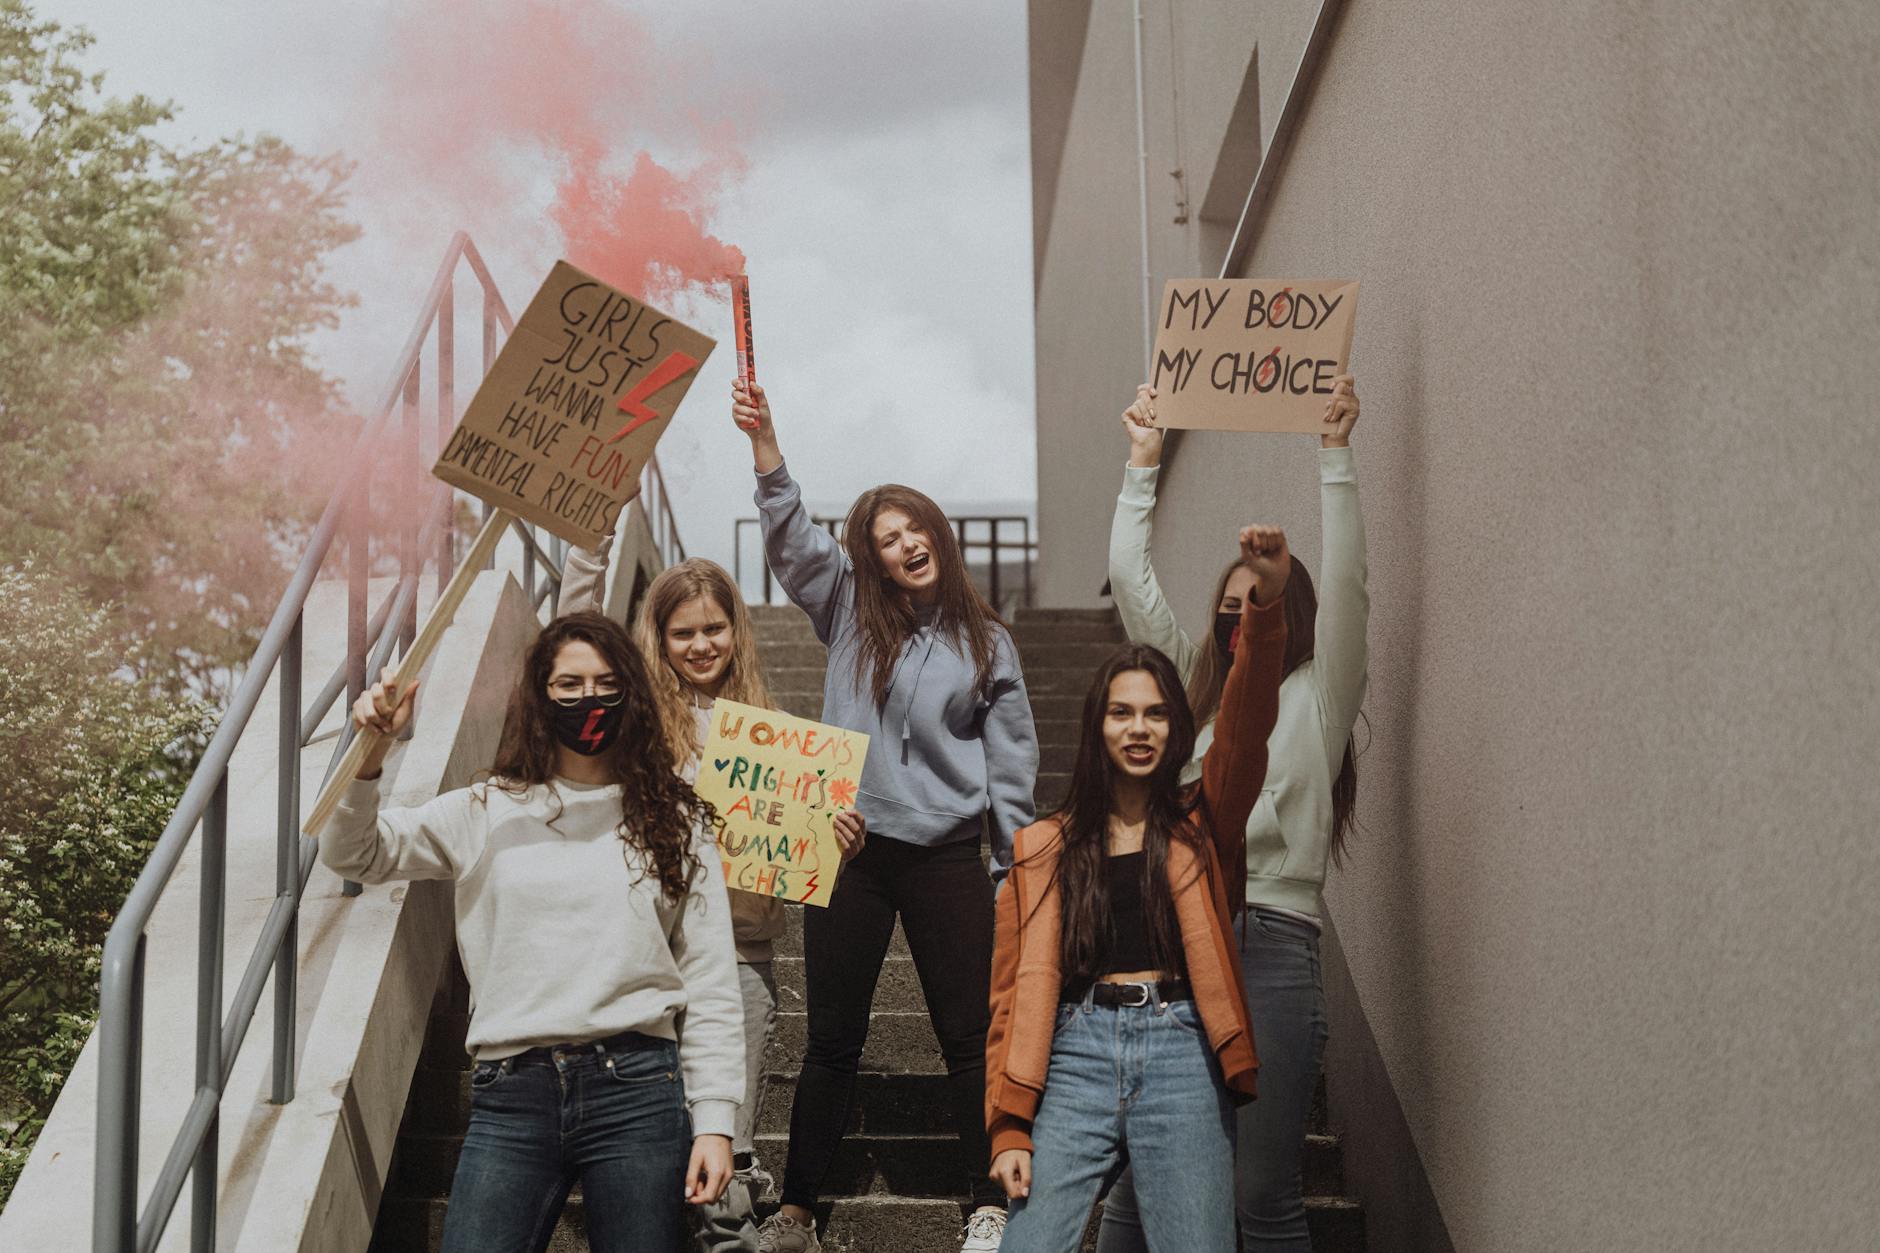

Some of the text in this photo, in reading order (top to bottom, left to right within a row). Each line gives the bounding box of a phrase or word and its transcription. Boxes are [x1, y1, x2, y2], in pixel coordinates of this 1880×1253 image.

[560, 282, 671, 362] GIRLS
[1165, 287, 1343, 330] MY BODY
[543, 328, 643, 395] JUST
[1153, 347, 1338, 395] MY CHOICE
[524, 366, 605, 431] WANNA
[498, 402, 568, 457] HAVE
[441, 425, 616, 533] DAMENTAL RIGHTS
[726, 795, 785, 826] ARE
